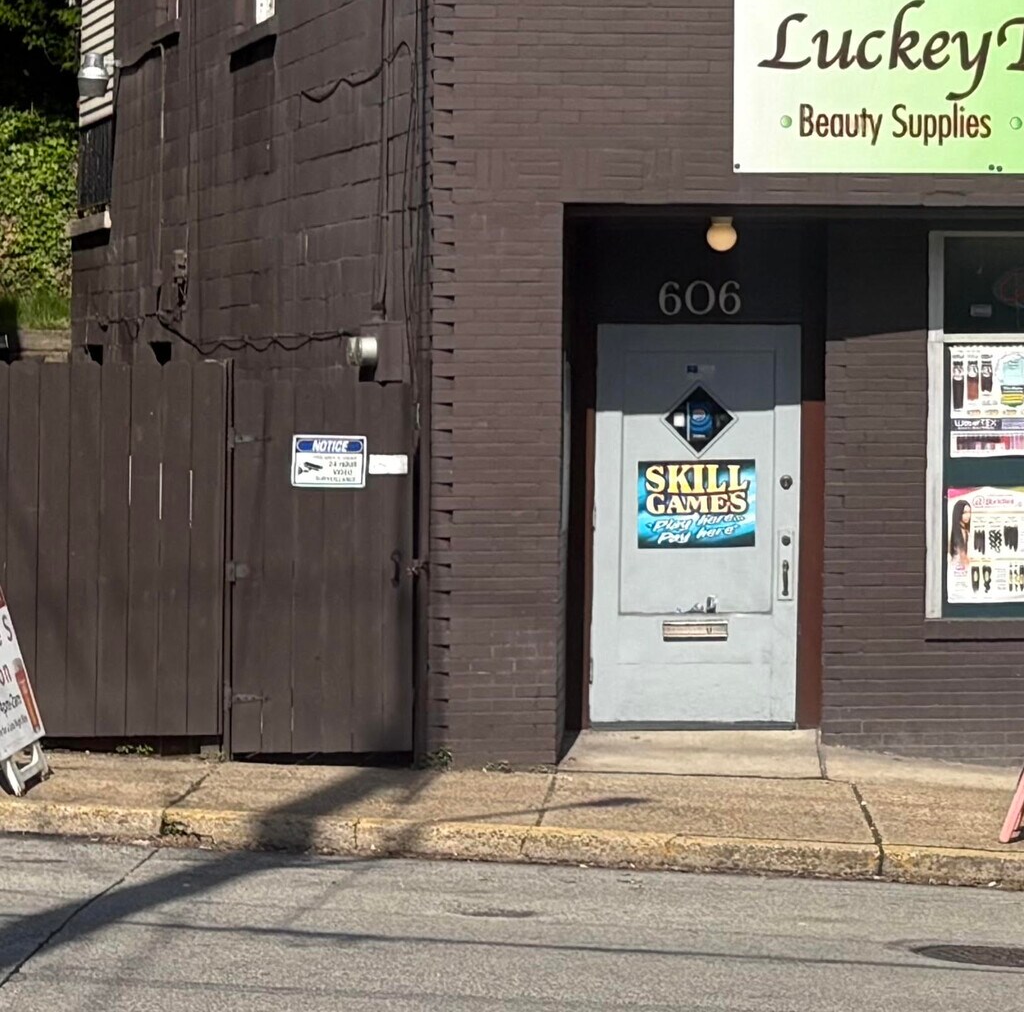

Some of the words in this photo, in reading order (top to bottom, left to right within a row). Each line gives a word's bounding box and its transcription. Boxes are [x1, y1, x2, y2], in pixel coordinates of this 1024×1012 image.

[799, 103, 883, 145] Beauty
[892, 103, 992, 146] Supplies
[658, 280, 742, 315] 606
[312, 439, 350, 452] NOTICE
[645, 464, 748, 493] SKILL
[646, 492, 747, 514] GAMES
[657, 531, 691, 544] Pay
